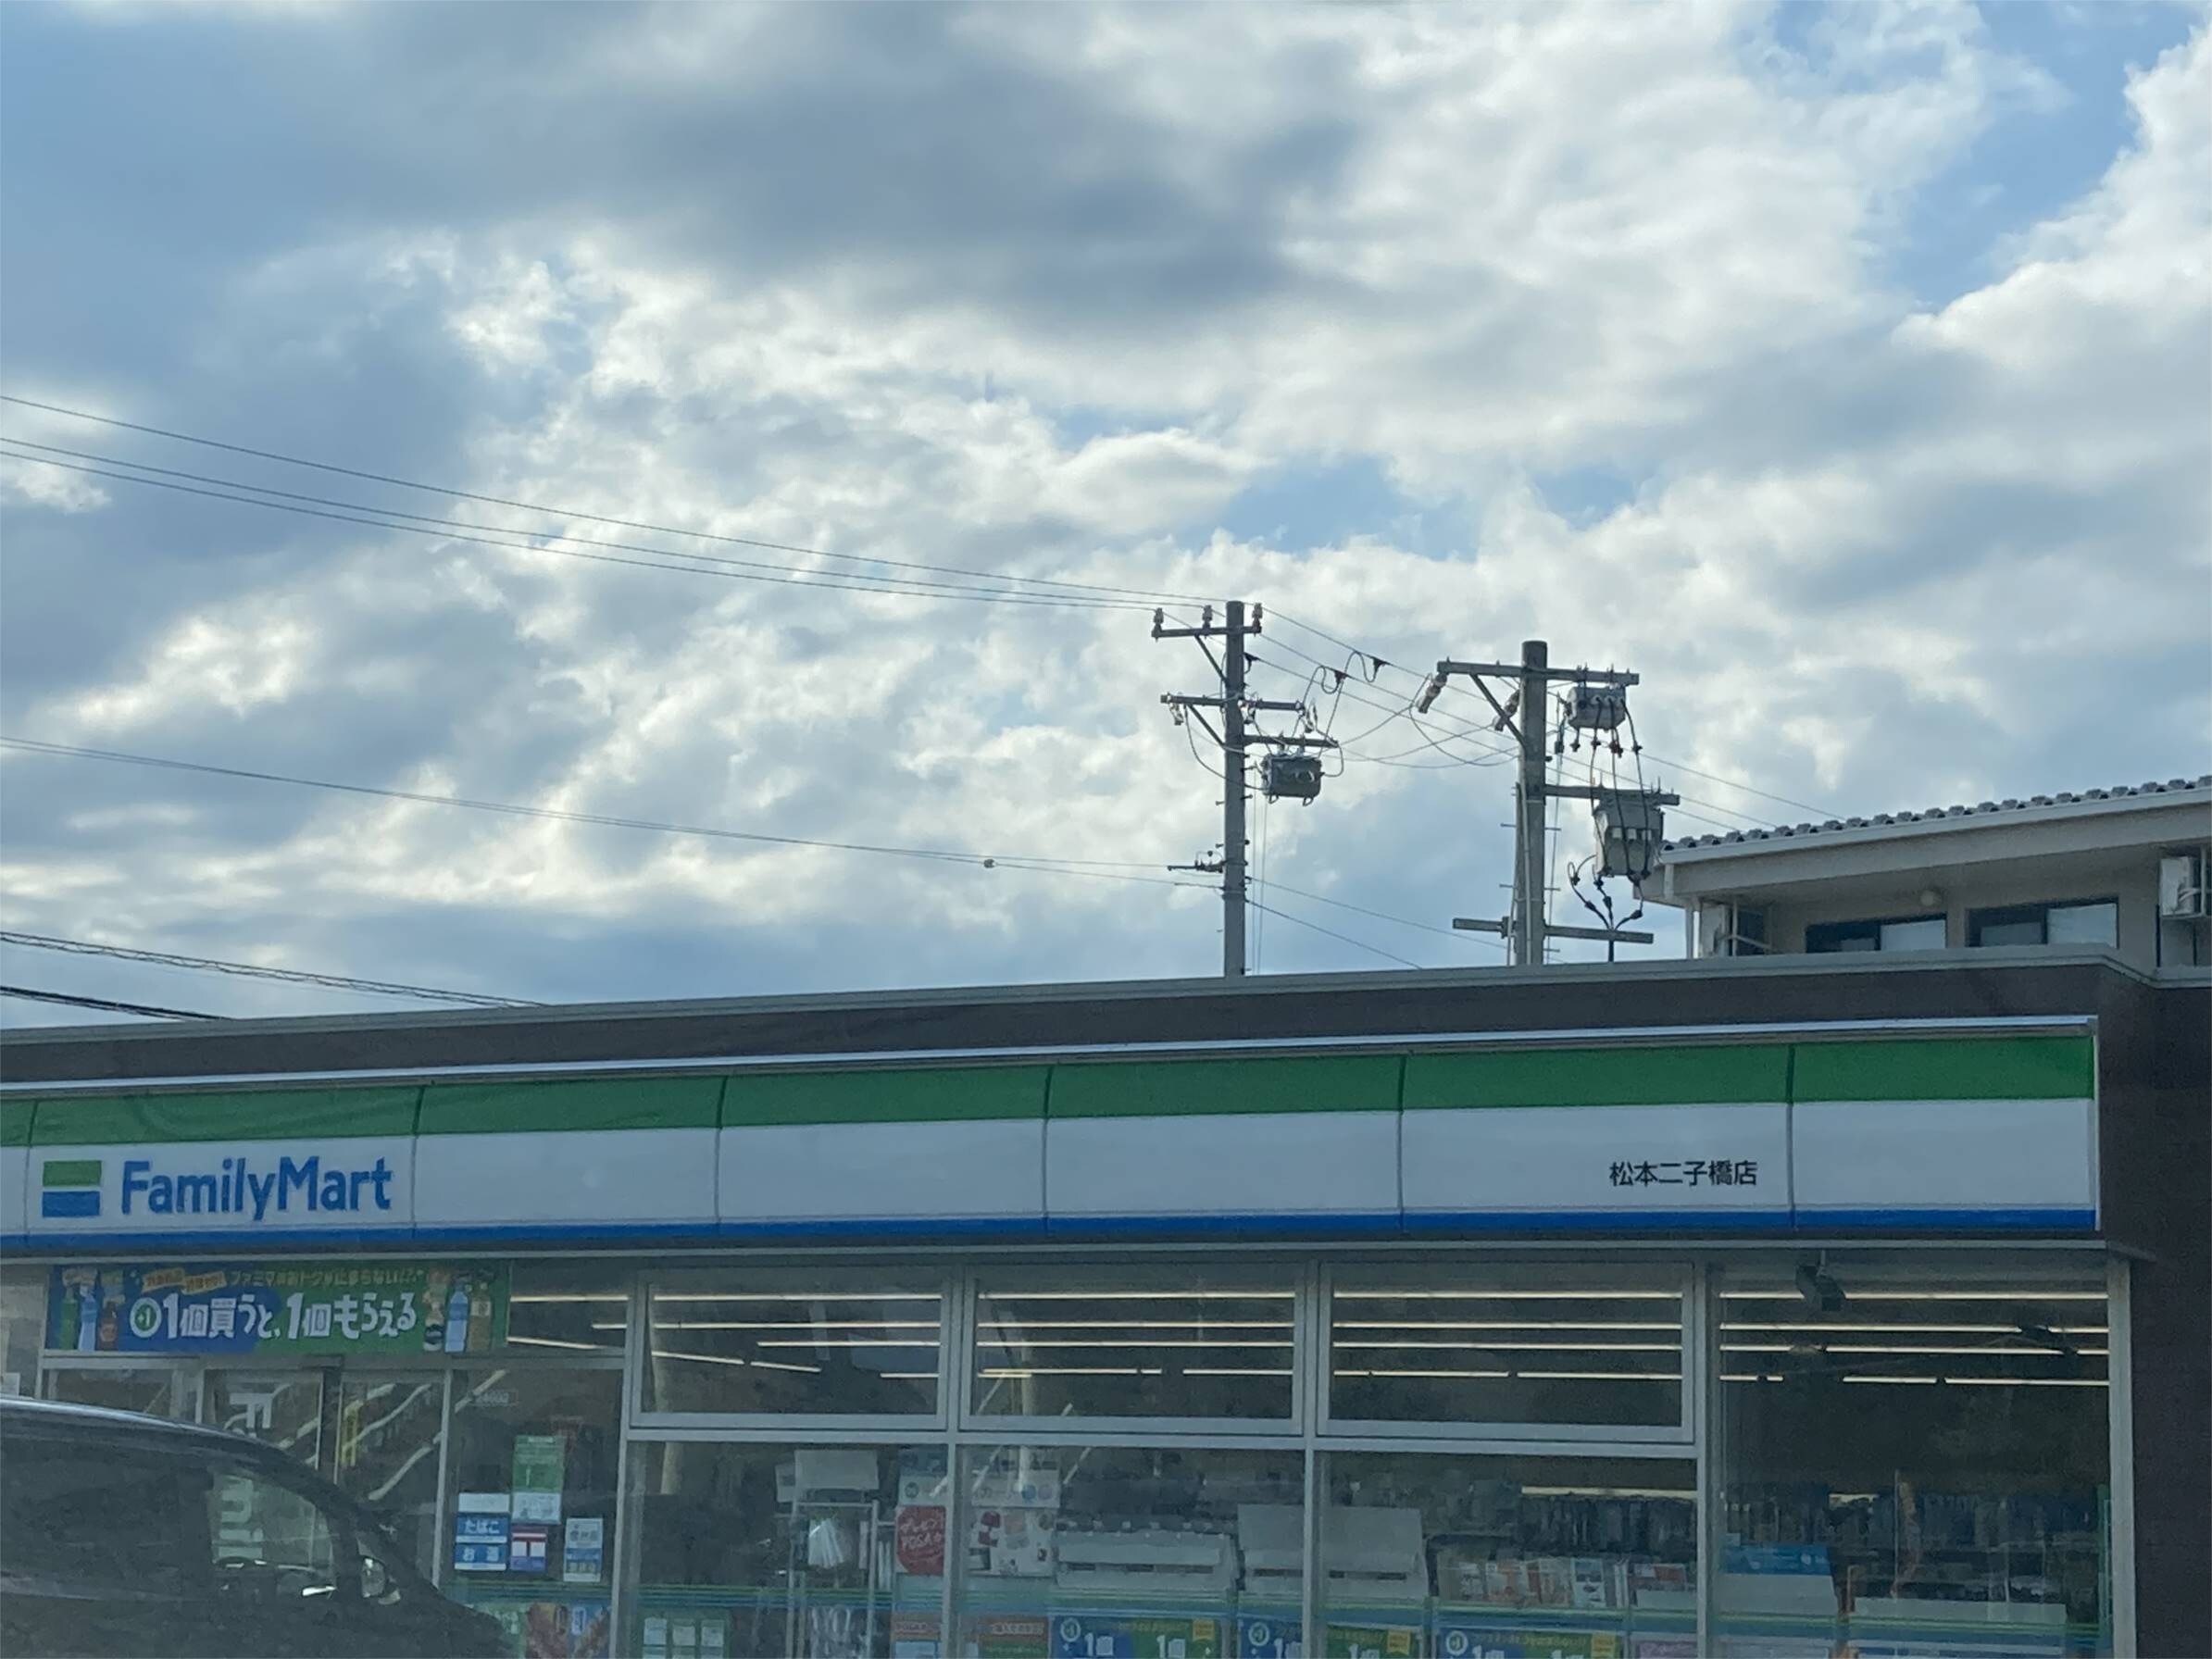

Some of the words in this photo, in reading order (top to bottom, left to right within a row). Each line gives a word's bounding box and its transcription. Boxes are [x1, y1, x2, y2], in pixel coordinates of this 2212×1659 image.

[122, 1156, 392, 1221] FamilyMart
[1609, 1160, 1758, 1187] 松本二子橋店
[162, 1292, 418, 1340] 1個買うと、1個もらえる
